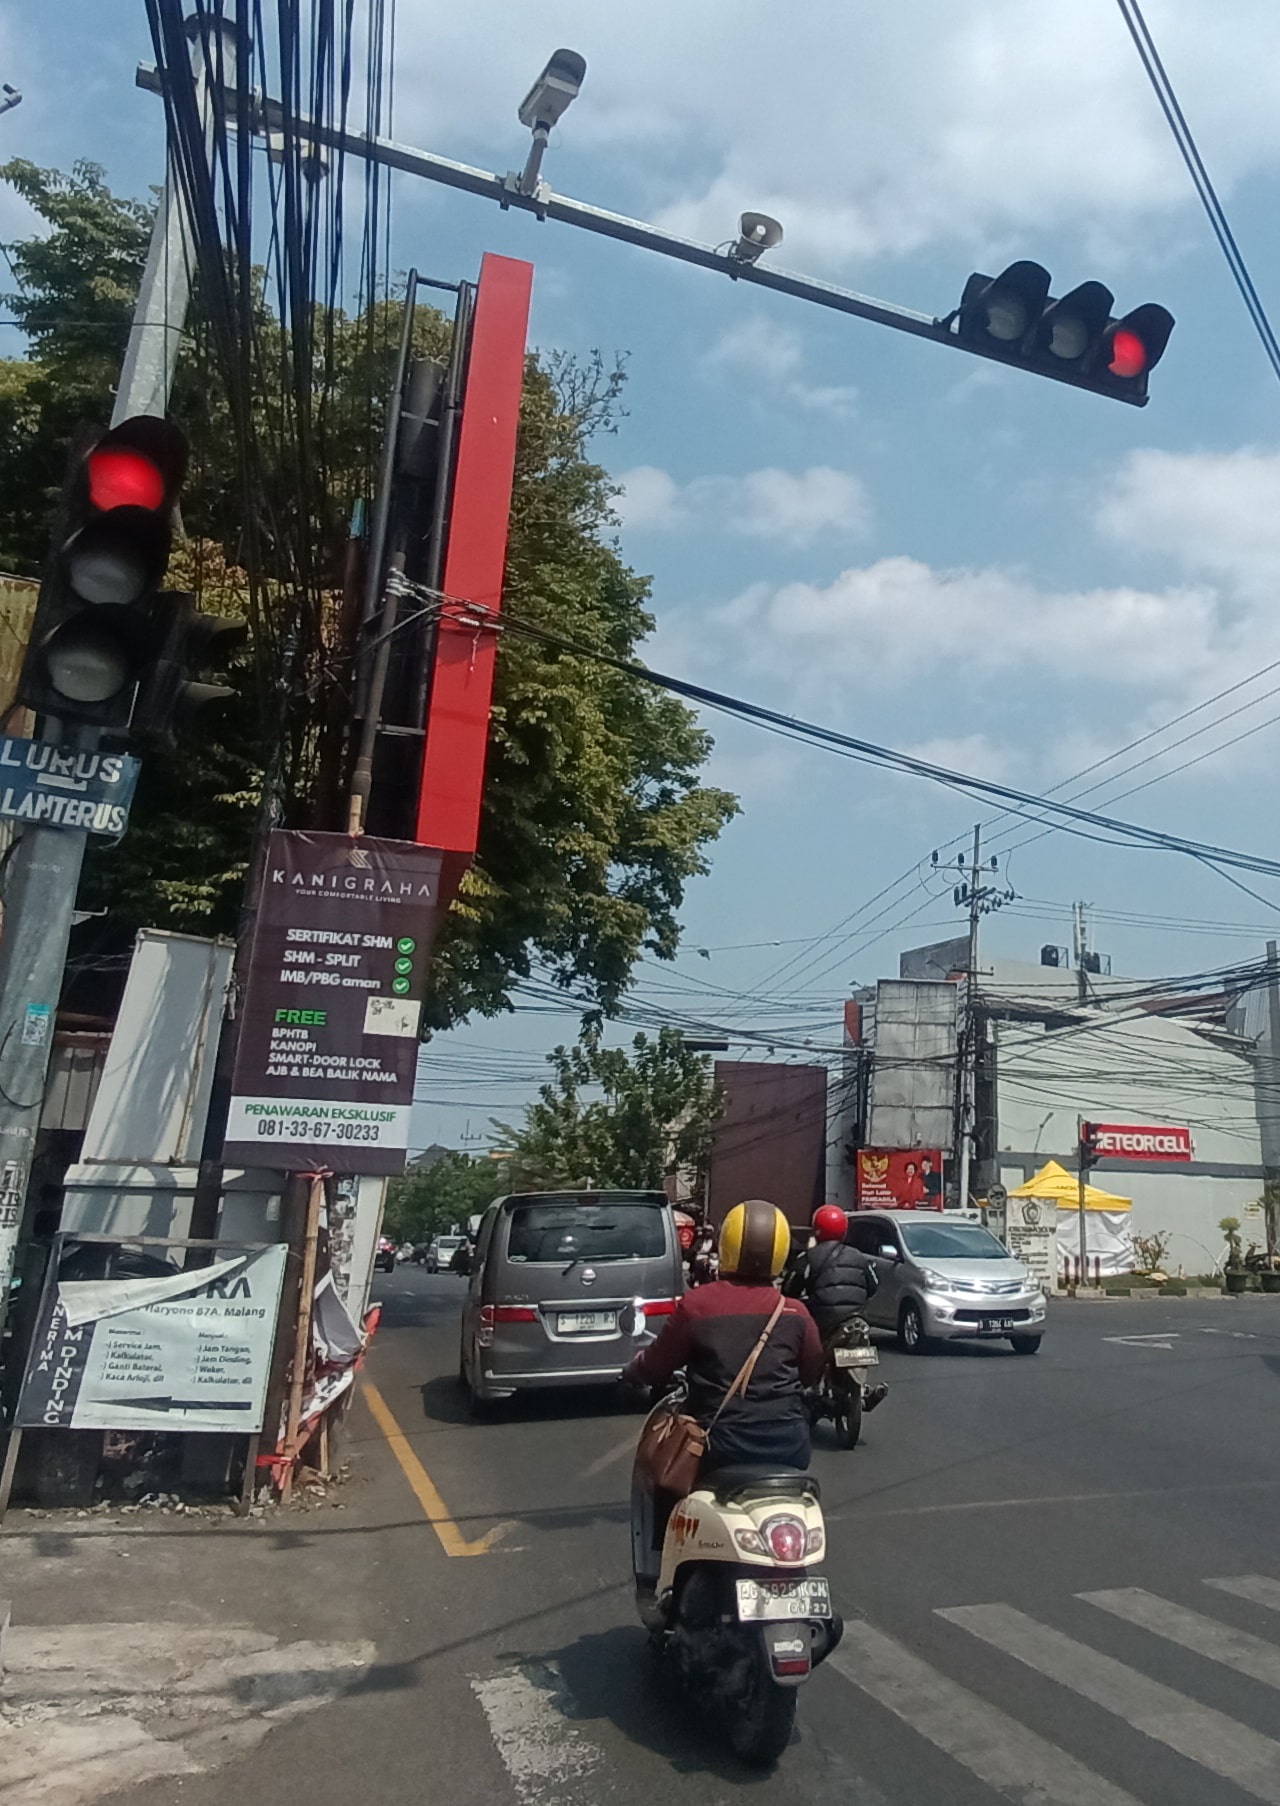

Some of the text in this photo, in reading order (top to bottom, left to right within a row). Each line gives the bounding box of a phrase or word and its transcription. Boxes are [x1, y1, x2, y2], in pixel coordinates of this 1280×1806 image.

[1, 740, 124, 784] LURUS
[272, 869, 431, 898] KANIGRAHA
[318, 890, 373, 902] COMFORTABLE
[375, 896, 402, 904] LIVING
[286, 928, 393, 949] SERTIFIKAT SHM
[283, 950, 315, 964] SHM
[325, 953, 361, 968] SPLIT
[280, 969, 381, 989] IMB/PBG aman
[274, 1008, 328, 1027] FREE
[272, 1027, 309, 1039] BPHTB
[270, 1040, 317, 1052] KANOPI
[268, 1052, 382, 1069] SMART-DOOR LOCK
[266, 1065, 399, 1083] AJB & BEA BALIK NAMA
[245, 1103, 398, 1123] PENAWARAN EKSKLUSIF
[257, 1119, 381, 1141] 081-33-67-30233
[1155, 1135, 1191, 1154] CELL
[223, 1306, 266, 1319] Malang
